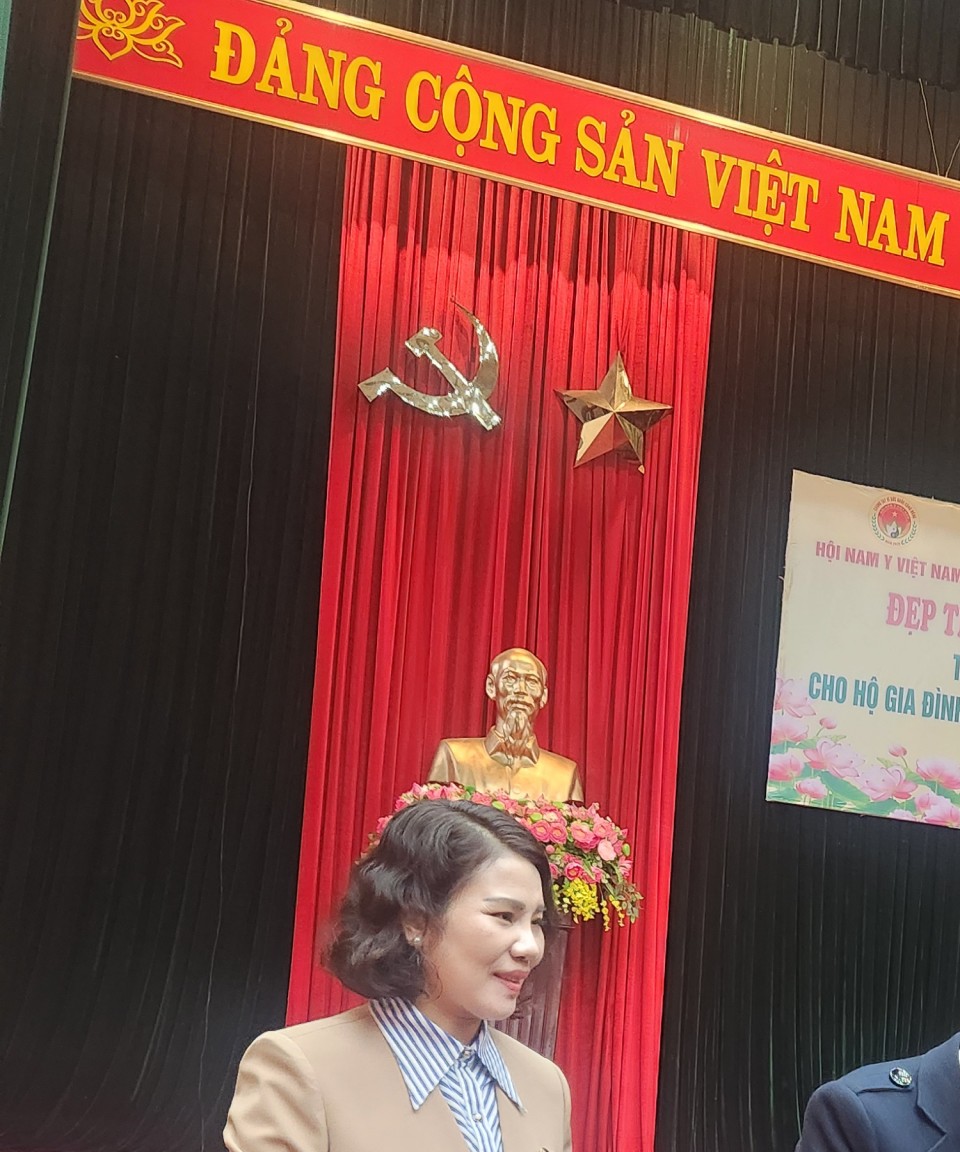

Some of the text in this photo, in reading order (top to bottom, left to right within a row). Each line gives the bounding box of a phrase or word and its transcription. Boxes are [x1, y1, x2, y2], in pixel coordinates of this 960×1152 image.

[209, 17, 385, 120] ĐẢNG
[405, 64, 561, 166] CỘNG
[575, 109, 683, 197] SẢN
[701, 150, 820, 237] VIỆT
[835, 186, 949, 267] NAM
[815, 540, 840, 562] HỘI
[845, 547, 879, 568] NAM
[884, 555, 893, 571] Y
[897, 556, 927, 578] VIỆT
[886, 592, 937, 636] ĐẸP
[808, 671, 847, 704] CHO
[853, 676, 879, 715] HỘ
[884, 685, 915, 716] GIA
